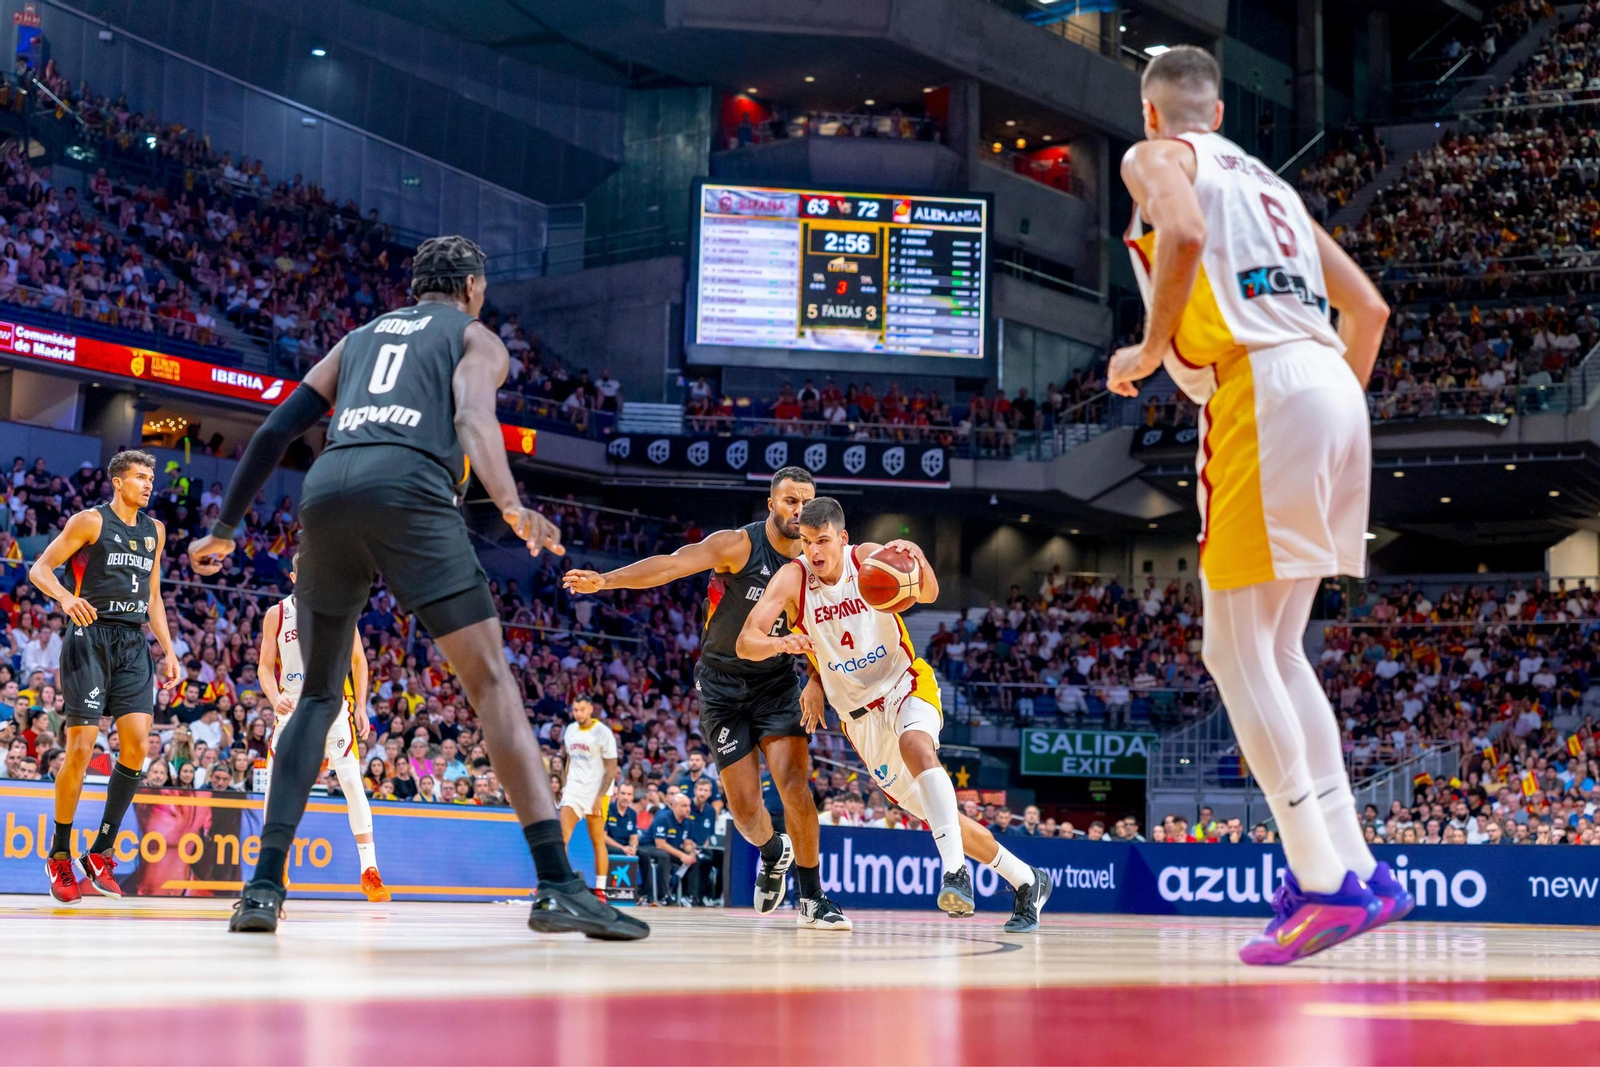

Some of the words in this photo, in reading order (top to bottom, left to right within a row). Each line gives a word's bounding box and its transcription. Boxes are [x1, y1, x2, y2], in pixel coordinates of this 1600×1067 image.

[807, 198, 830, 215] 63
[857, 201, 880, 218] 72
[1260, 192, 1298, 258] 6
[824, 232, 871, 254] 2:56
[836, 279, 848, 295] 3
[807, 303, 818, 319] 5
[865, 305, 877, 321] 3
[15, 326, 76, 349] Comunidad
[33, 341, 76, 362] Madrid
[211, 368, 263, 391] IBERIA
[368, 343, 408, 394] 0
[131, 573, 139, 593] 5
[108, 600, 136, 613] ING
[814, 597, 868, 625] ESPAÑA
[840, 630, 855, 650] 4
[1029, 732, 1148, 757] SALIDA
[1062, 756, 1116, 775] EXIT
[4, 812, 167, 864] blnco
[178, 832, 204, 865] o
[213, 833, 333, 869] nero
[1065, 863, 1116, 890] travel
[1157, 852, 1487, 908] azulino
[1528, 876, 1600, 899] new
